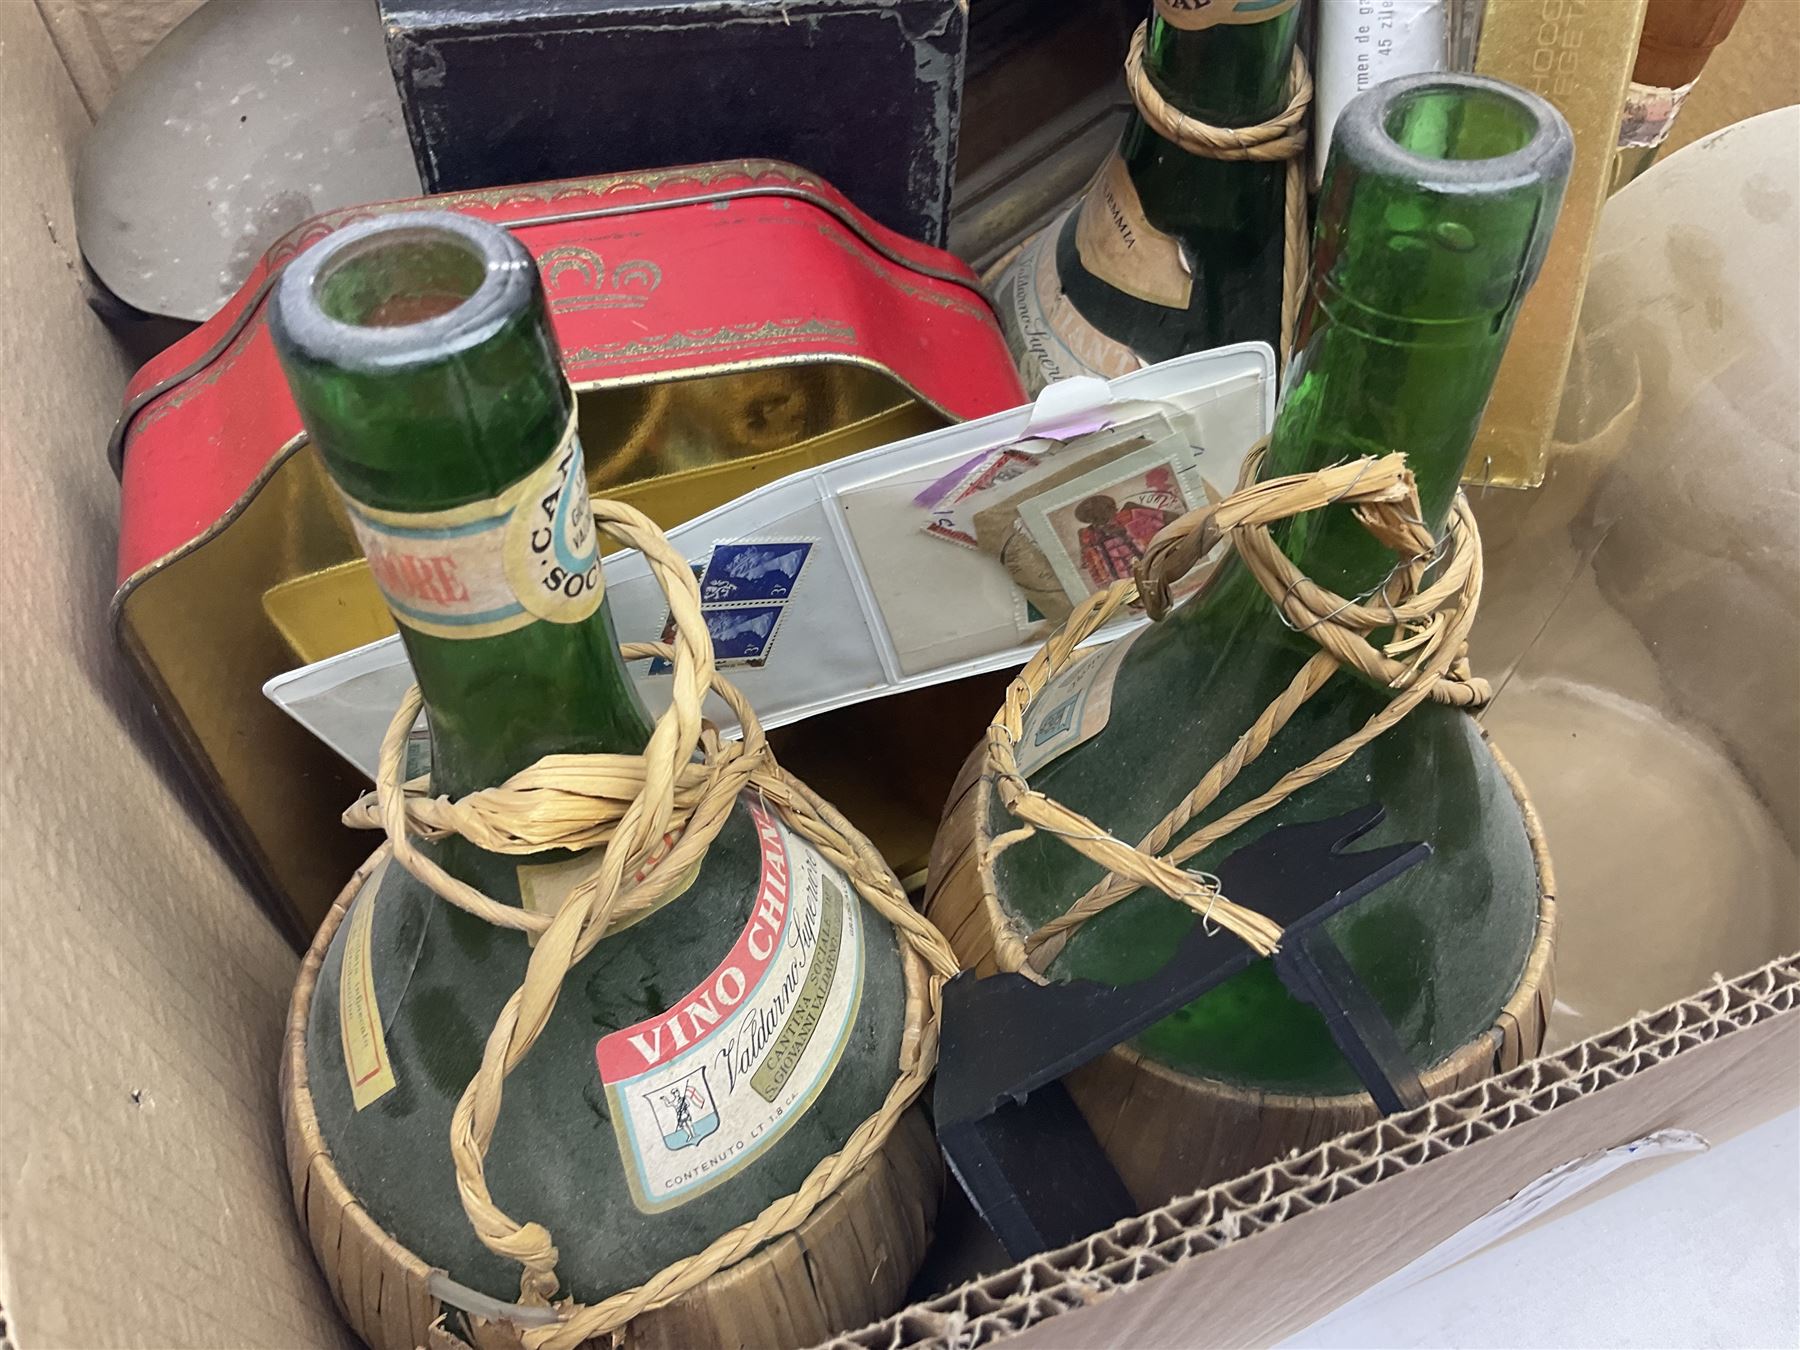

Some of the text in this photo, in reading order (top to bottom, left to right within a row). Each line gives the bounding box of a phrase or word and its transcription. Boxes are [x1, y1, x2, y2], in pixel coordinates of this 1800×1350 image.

[1354, 25, 1370, 43] de
[1378, 1, 1394, 56] 45 zile
[627, 966, 746, 1067] VINO
[714, 956, 801, 1096] Valdarno
[766, 995, 812, 1071] CANTINA
[810, 917, 832, 986] SOCIALE
[664, 1140, 744, 1189] CONTENUTO
[750, 1123, 765, 1139] LT
